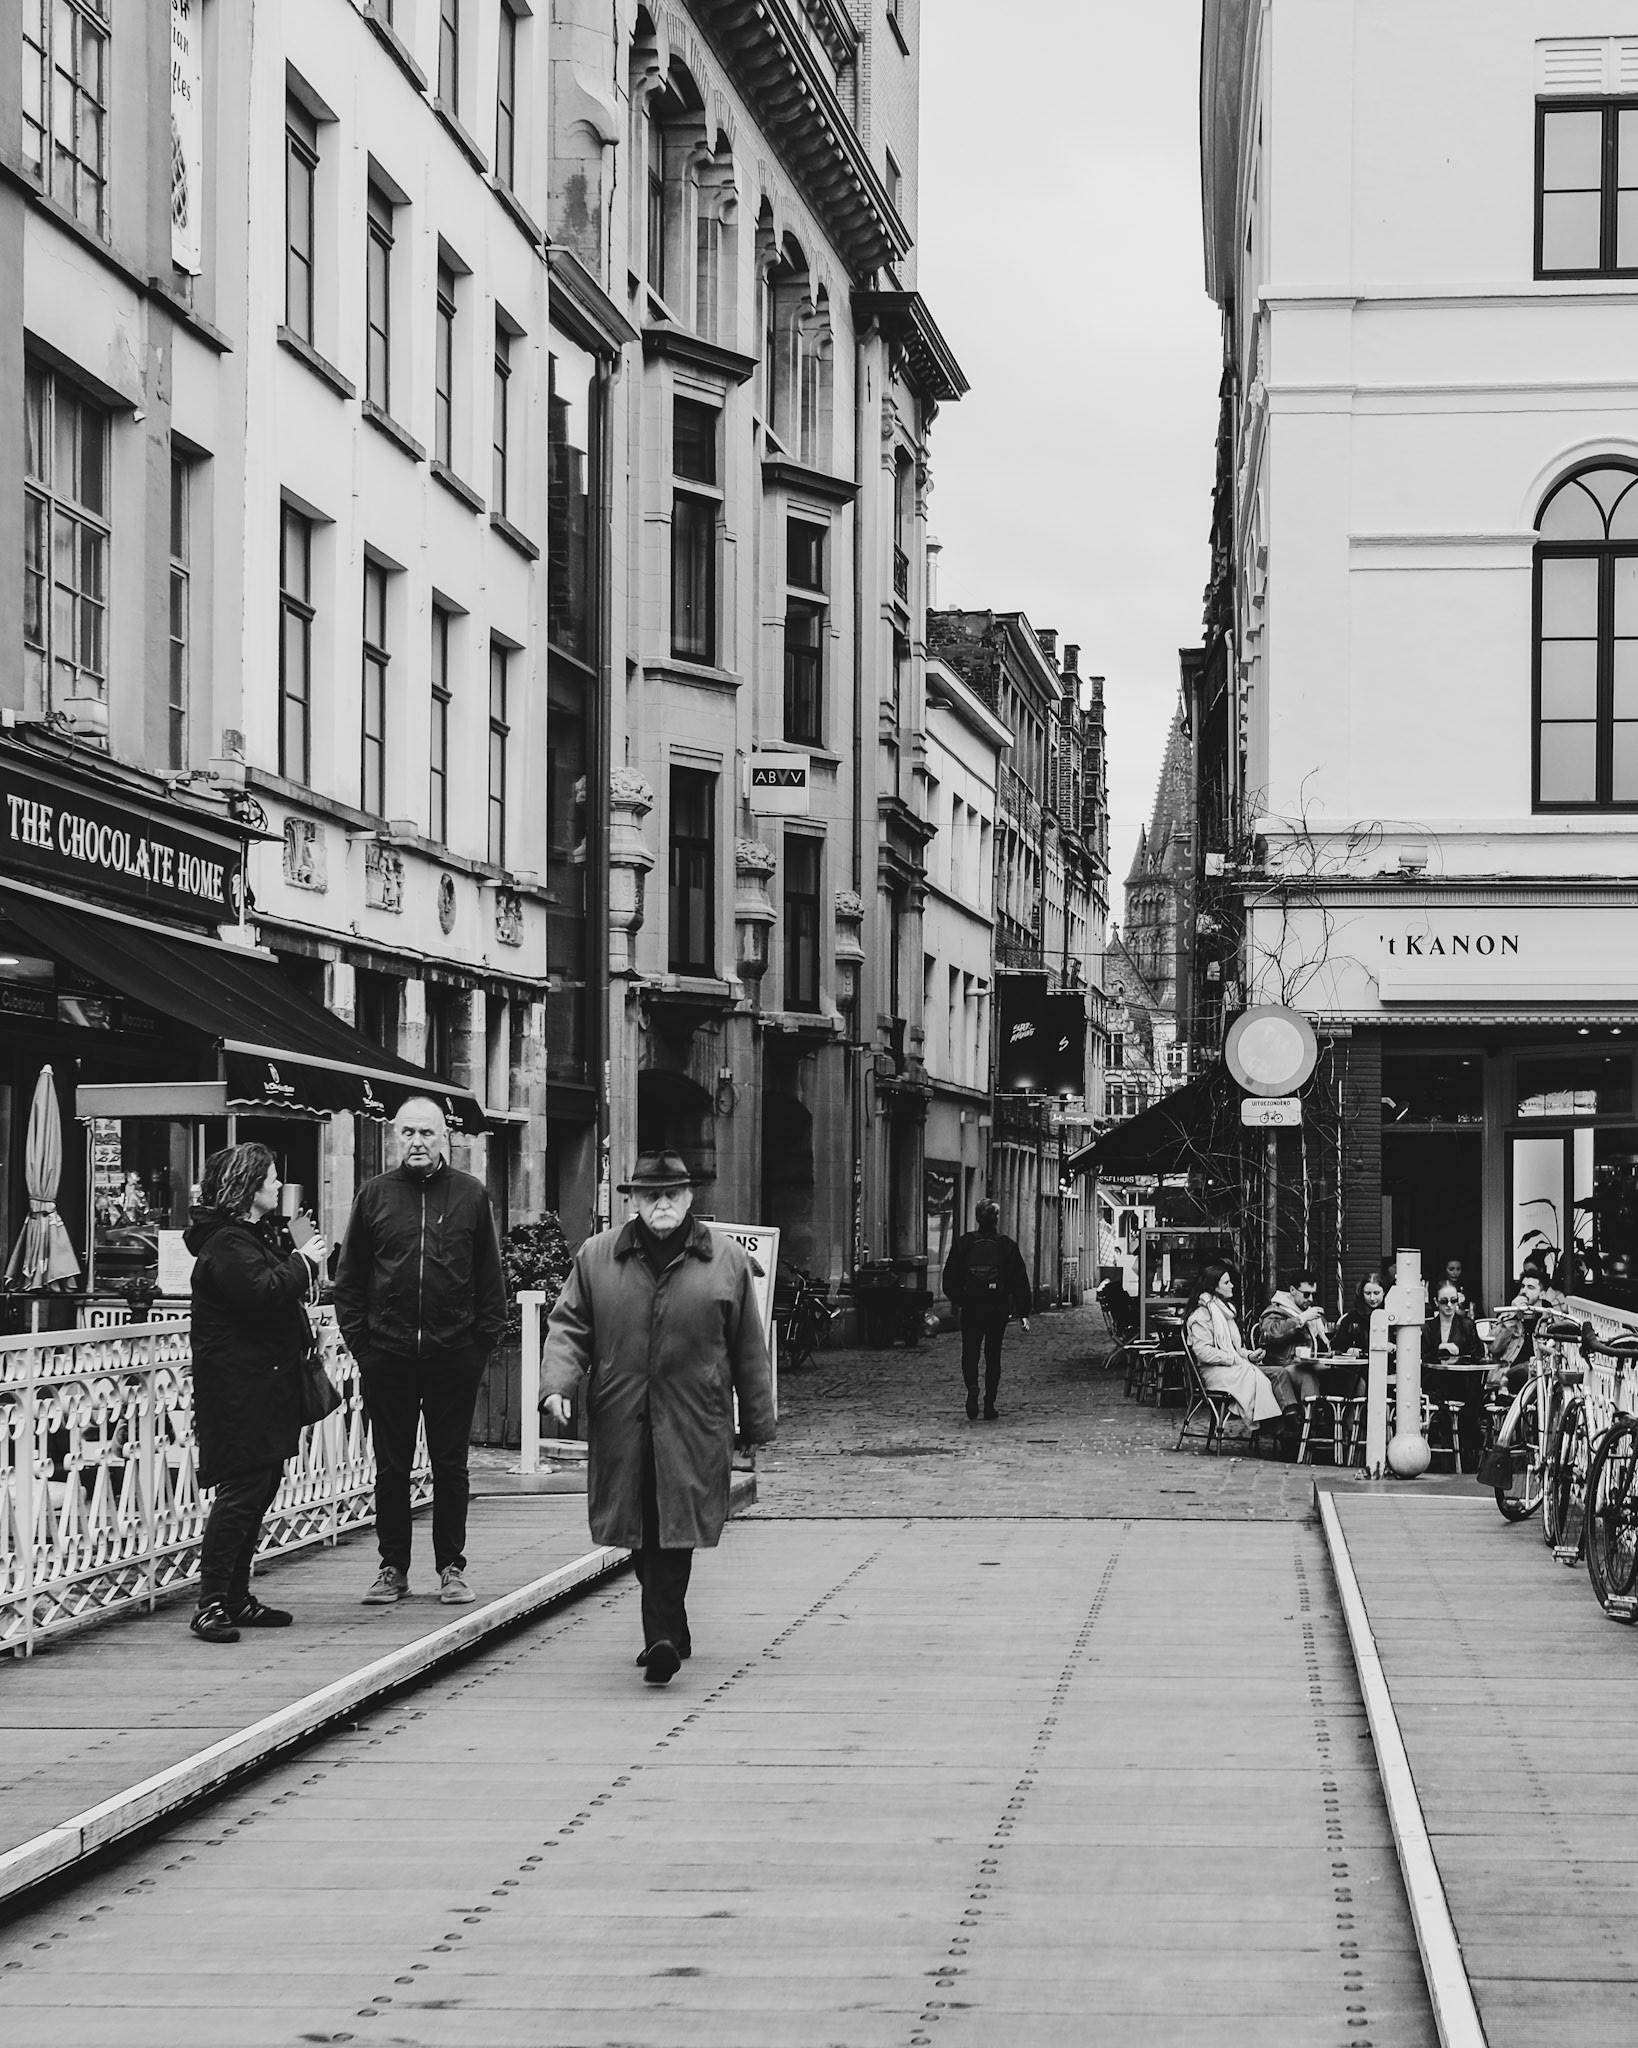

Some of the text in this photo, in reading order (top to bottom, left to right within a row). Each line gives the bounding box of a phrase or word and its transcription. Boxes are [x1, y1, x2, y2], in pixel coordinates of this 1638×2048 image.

[754, 769, 802, 785] ABVV
[6, 793, 225, 904] THE CHOCOLATE HOME
[1379, 934, 1519, 956] 't KANON
